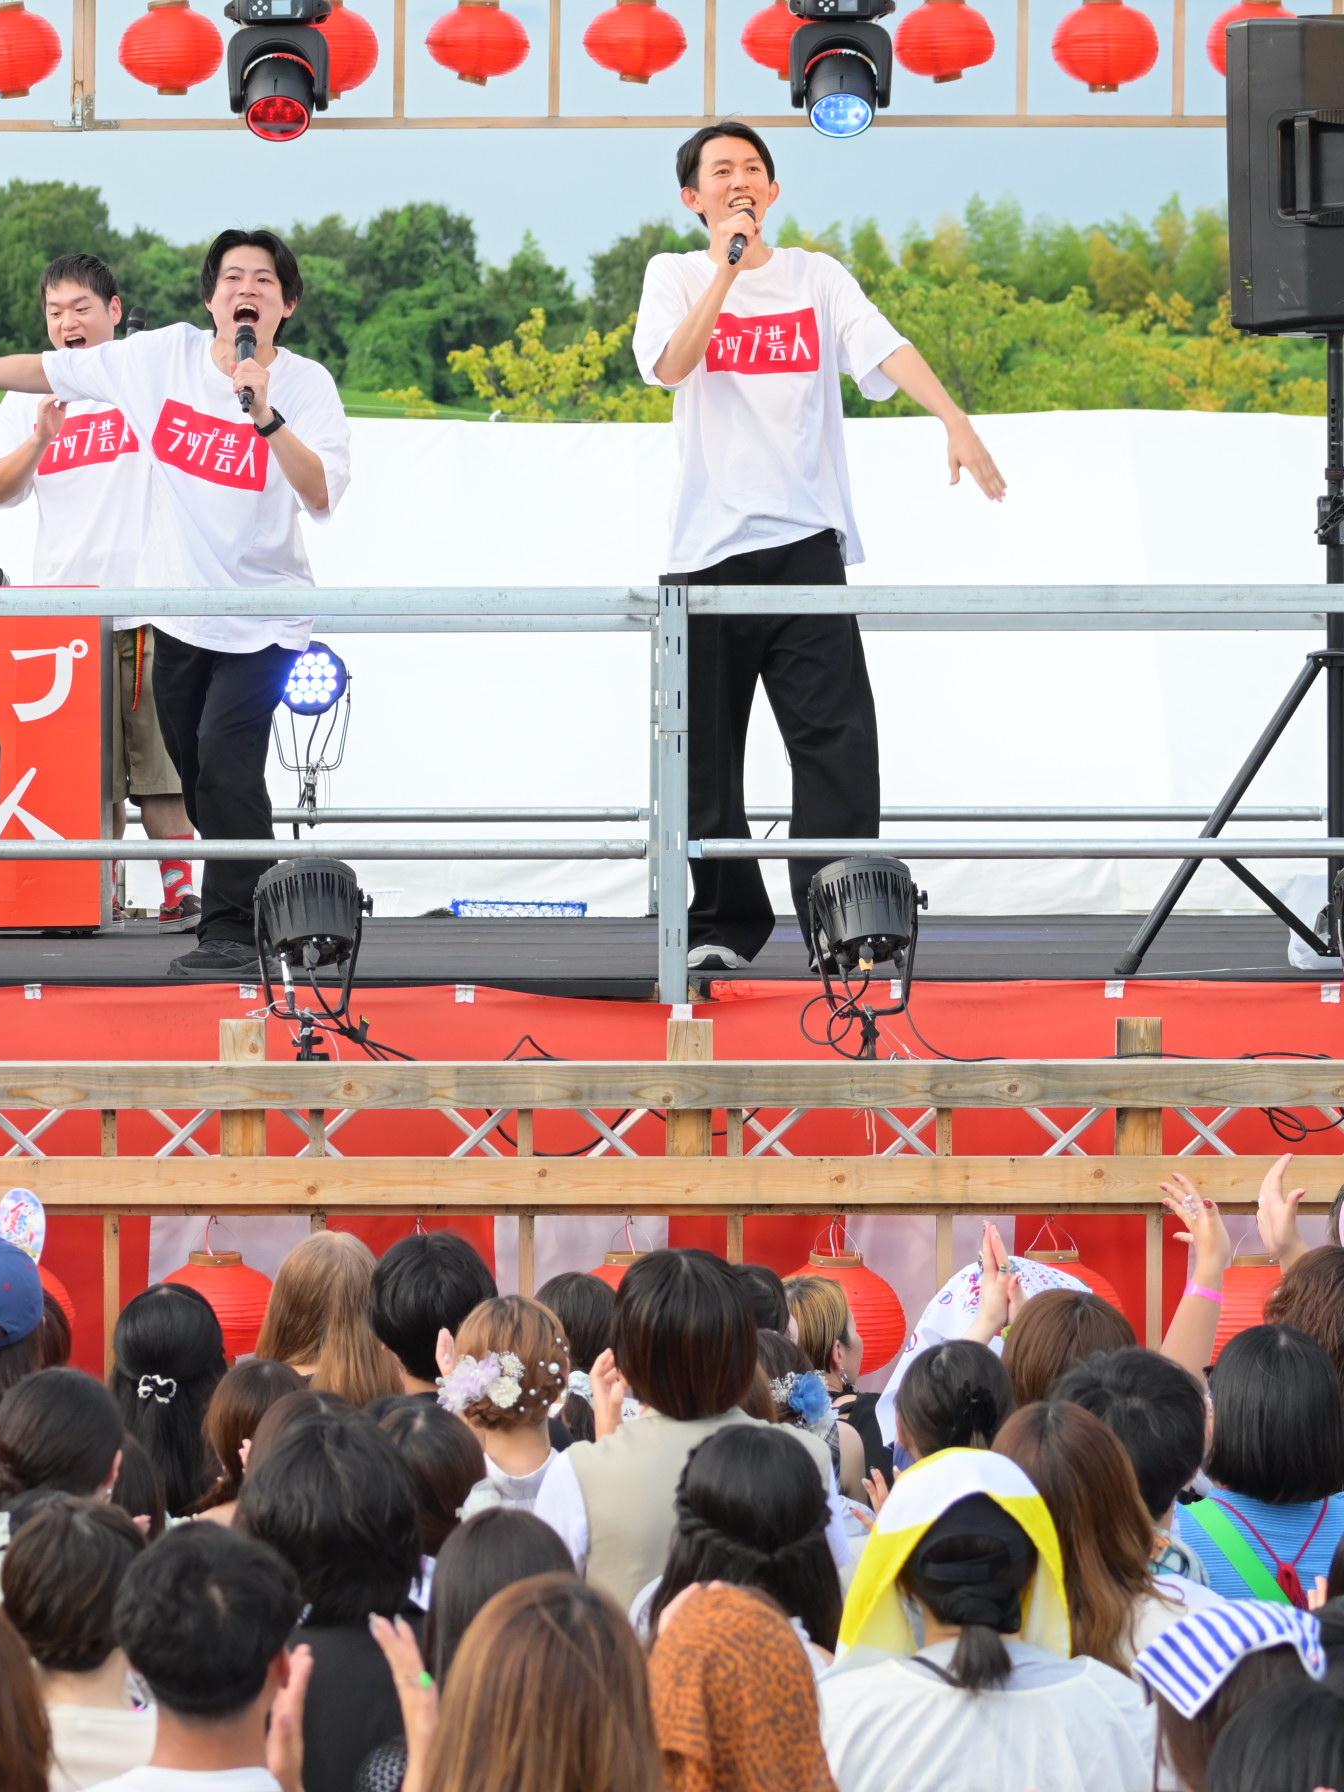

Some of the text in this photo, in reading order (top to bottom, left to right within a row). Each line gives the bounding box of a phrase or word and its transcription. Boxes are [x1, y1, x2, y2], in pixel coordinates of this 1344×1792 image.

[711, 322, 811, 363] ラップ芸人
[167, 418, 256, 478] ラップ芸人
